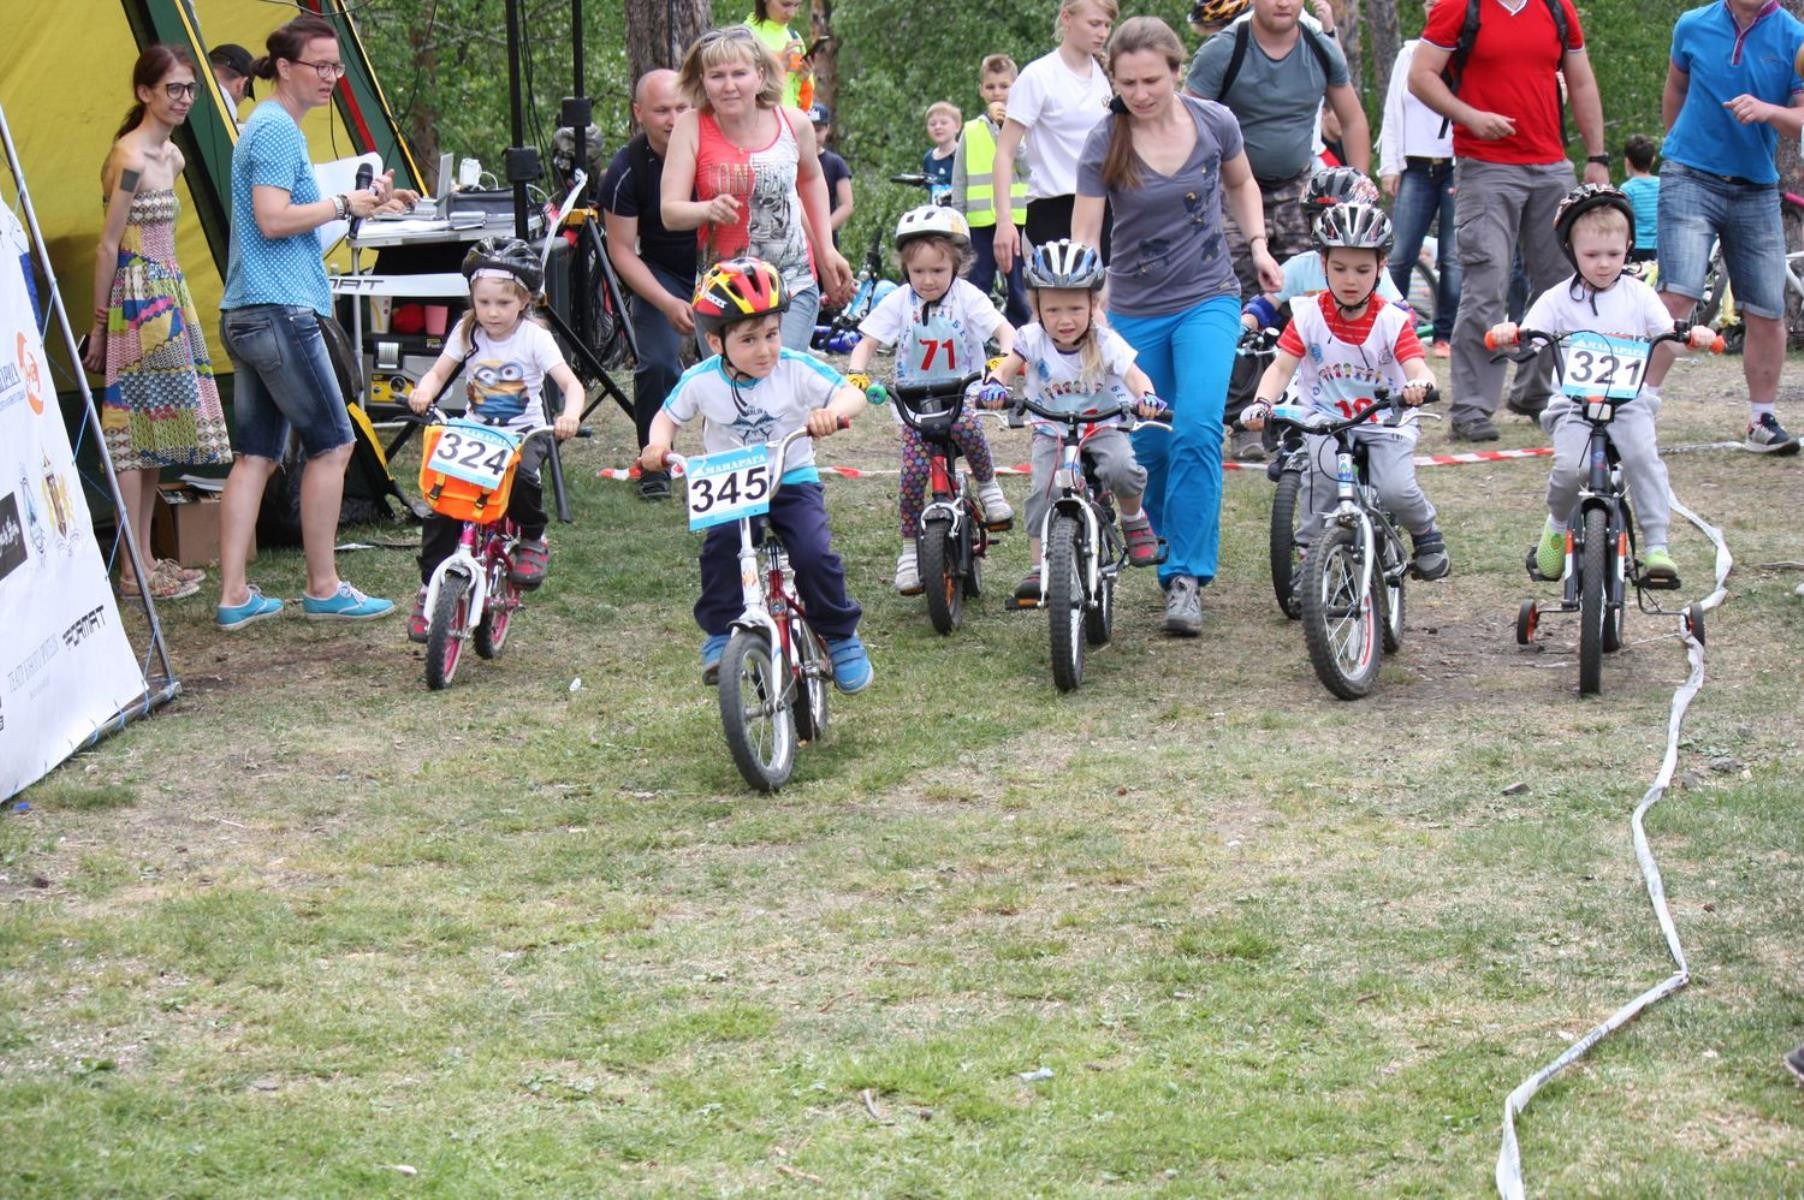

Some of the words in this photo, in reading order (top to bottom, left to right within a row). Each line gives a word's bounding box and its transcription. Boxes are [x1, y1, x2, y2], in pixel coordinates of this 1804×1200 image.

[919, 338, 956, 371] 71
[1570, 350, 1642, 386] 321
[437, 432, 509, 475] 324
[691, 466, 768, 513] 345
